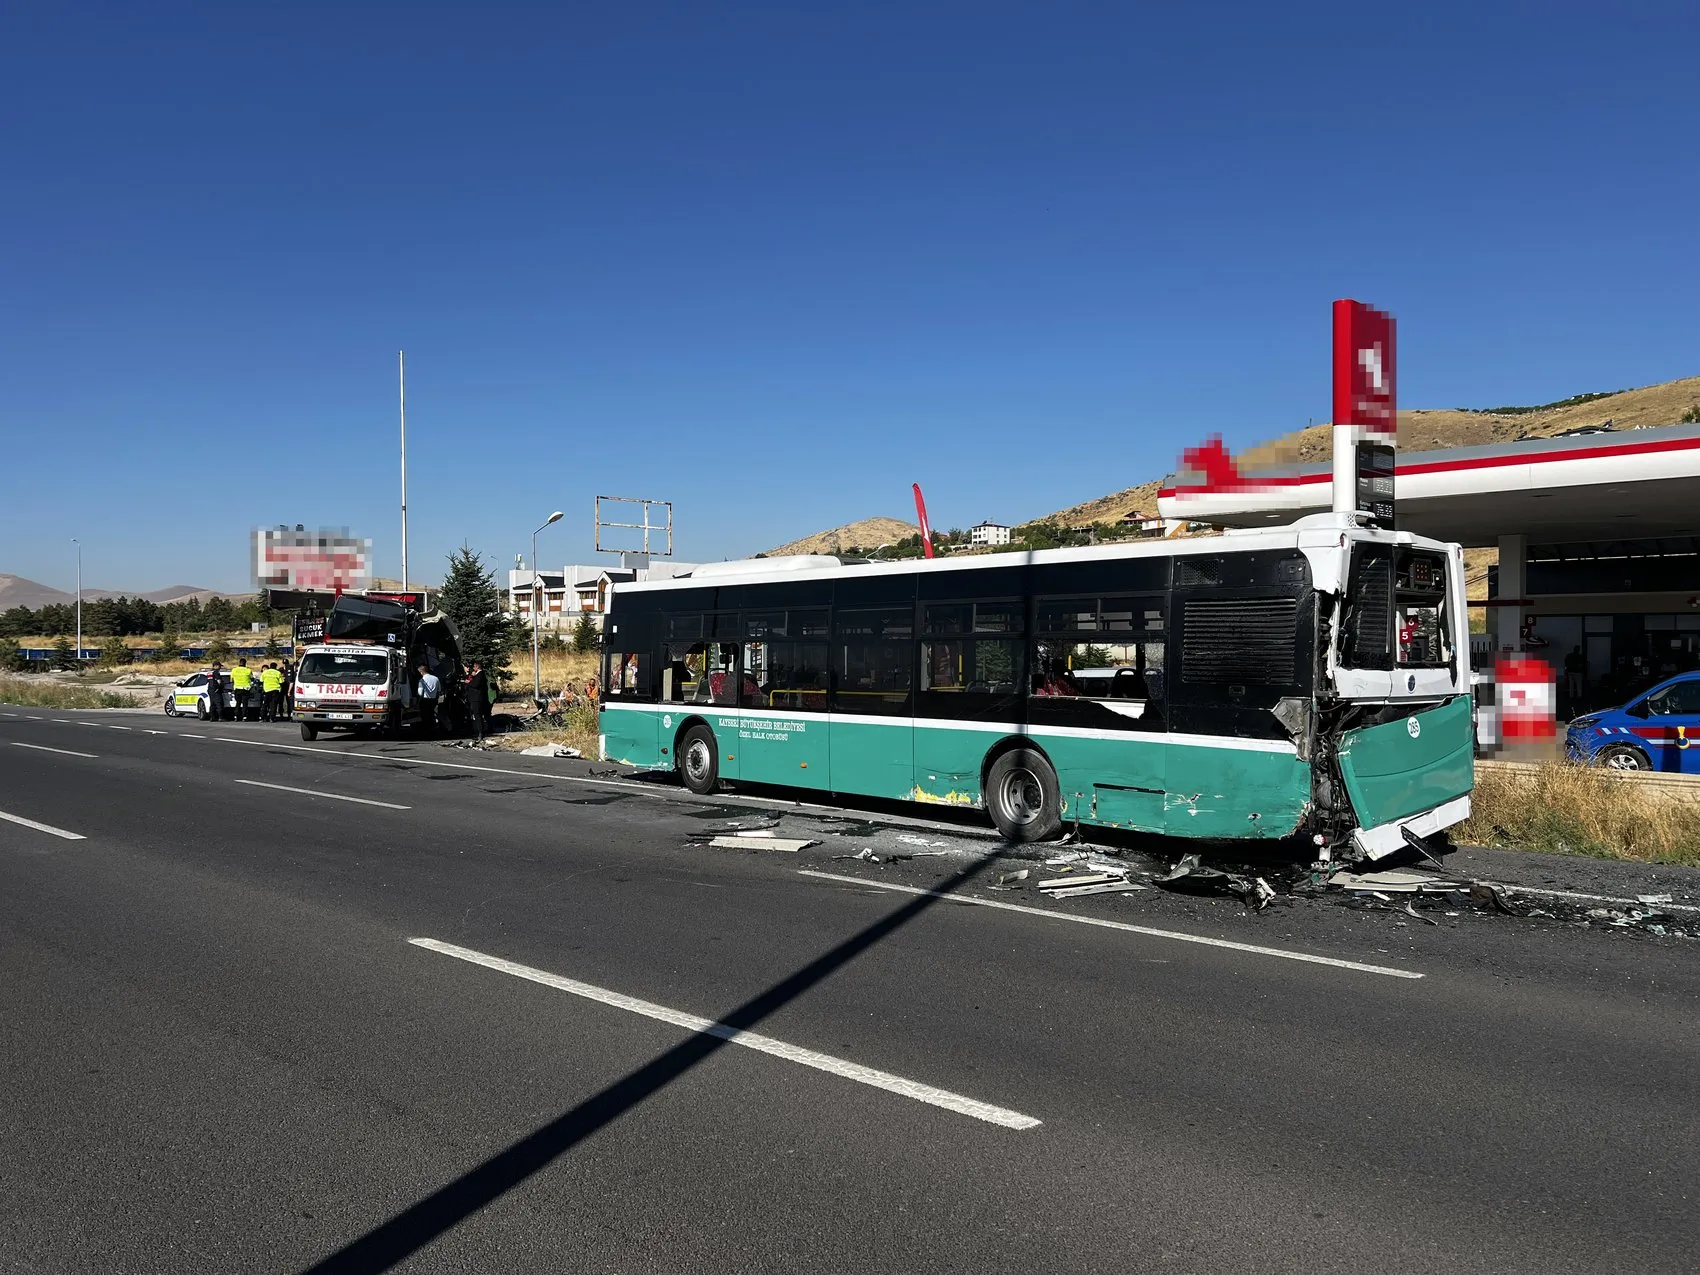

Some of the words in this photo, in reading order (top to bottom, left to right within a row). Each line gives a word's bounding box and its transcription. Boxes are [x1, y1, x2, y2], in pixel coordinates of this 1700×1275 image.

[299, 624, 322, 632] SUCUK
[298, 630, 324, 639] EKMEK
[1401, 631, 1409, 640] 5
[752, 732, 766, 740] HALK
